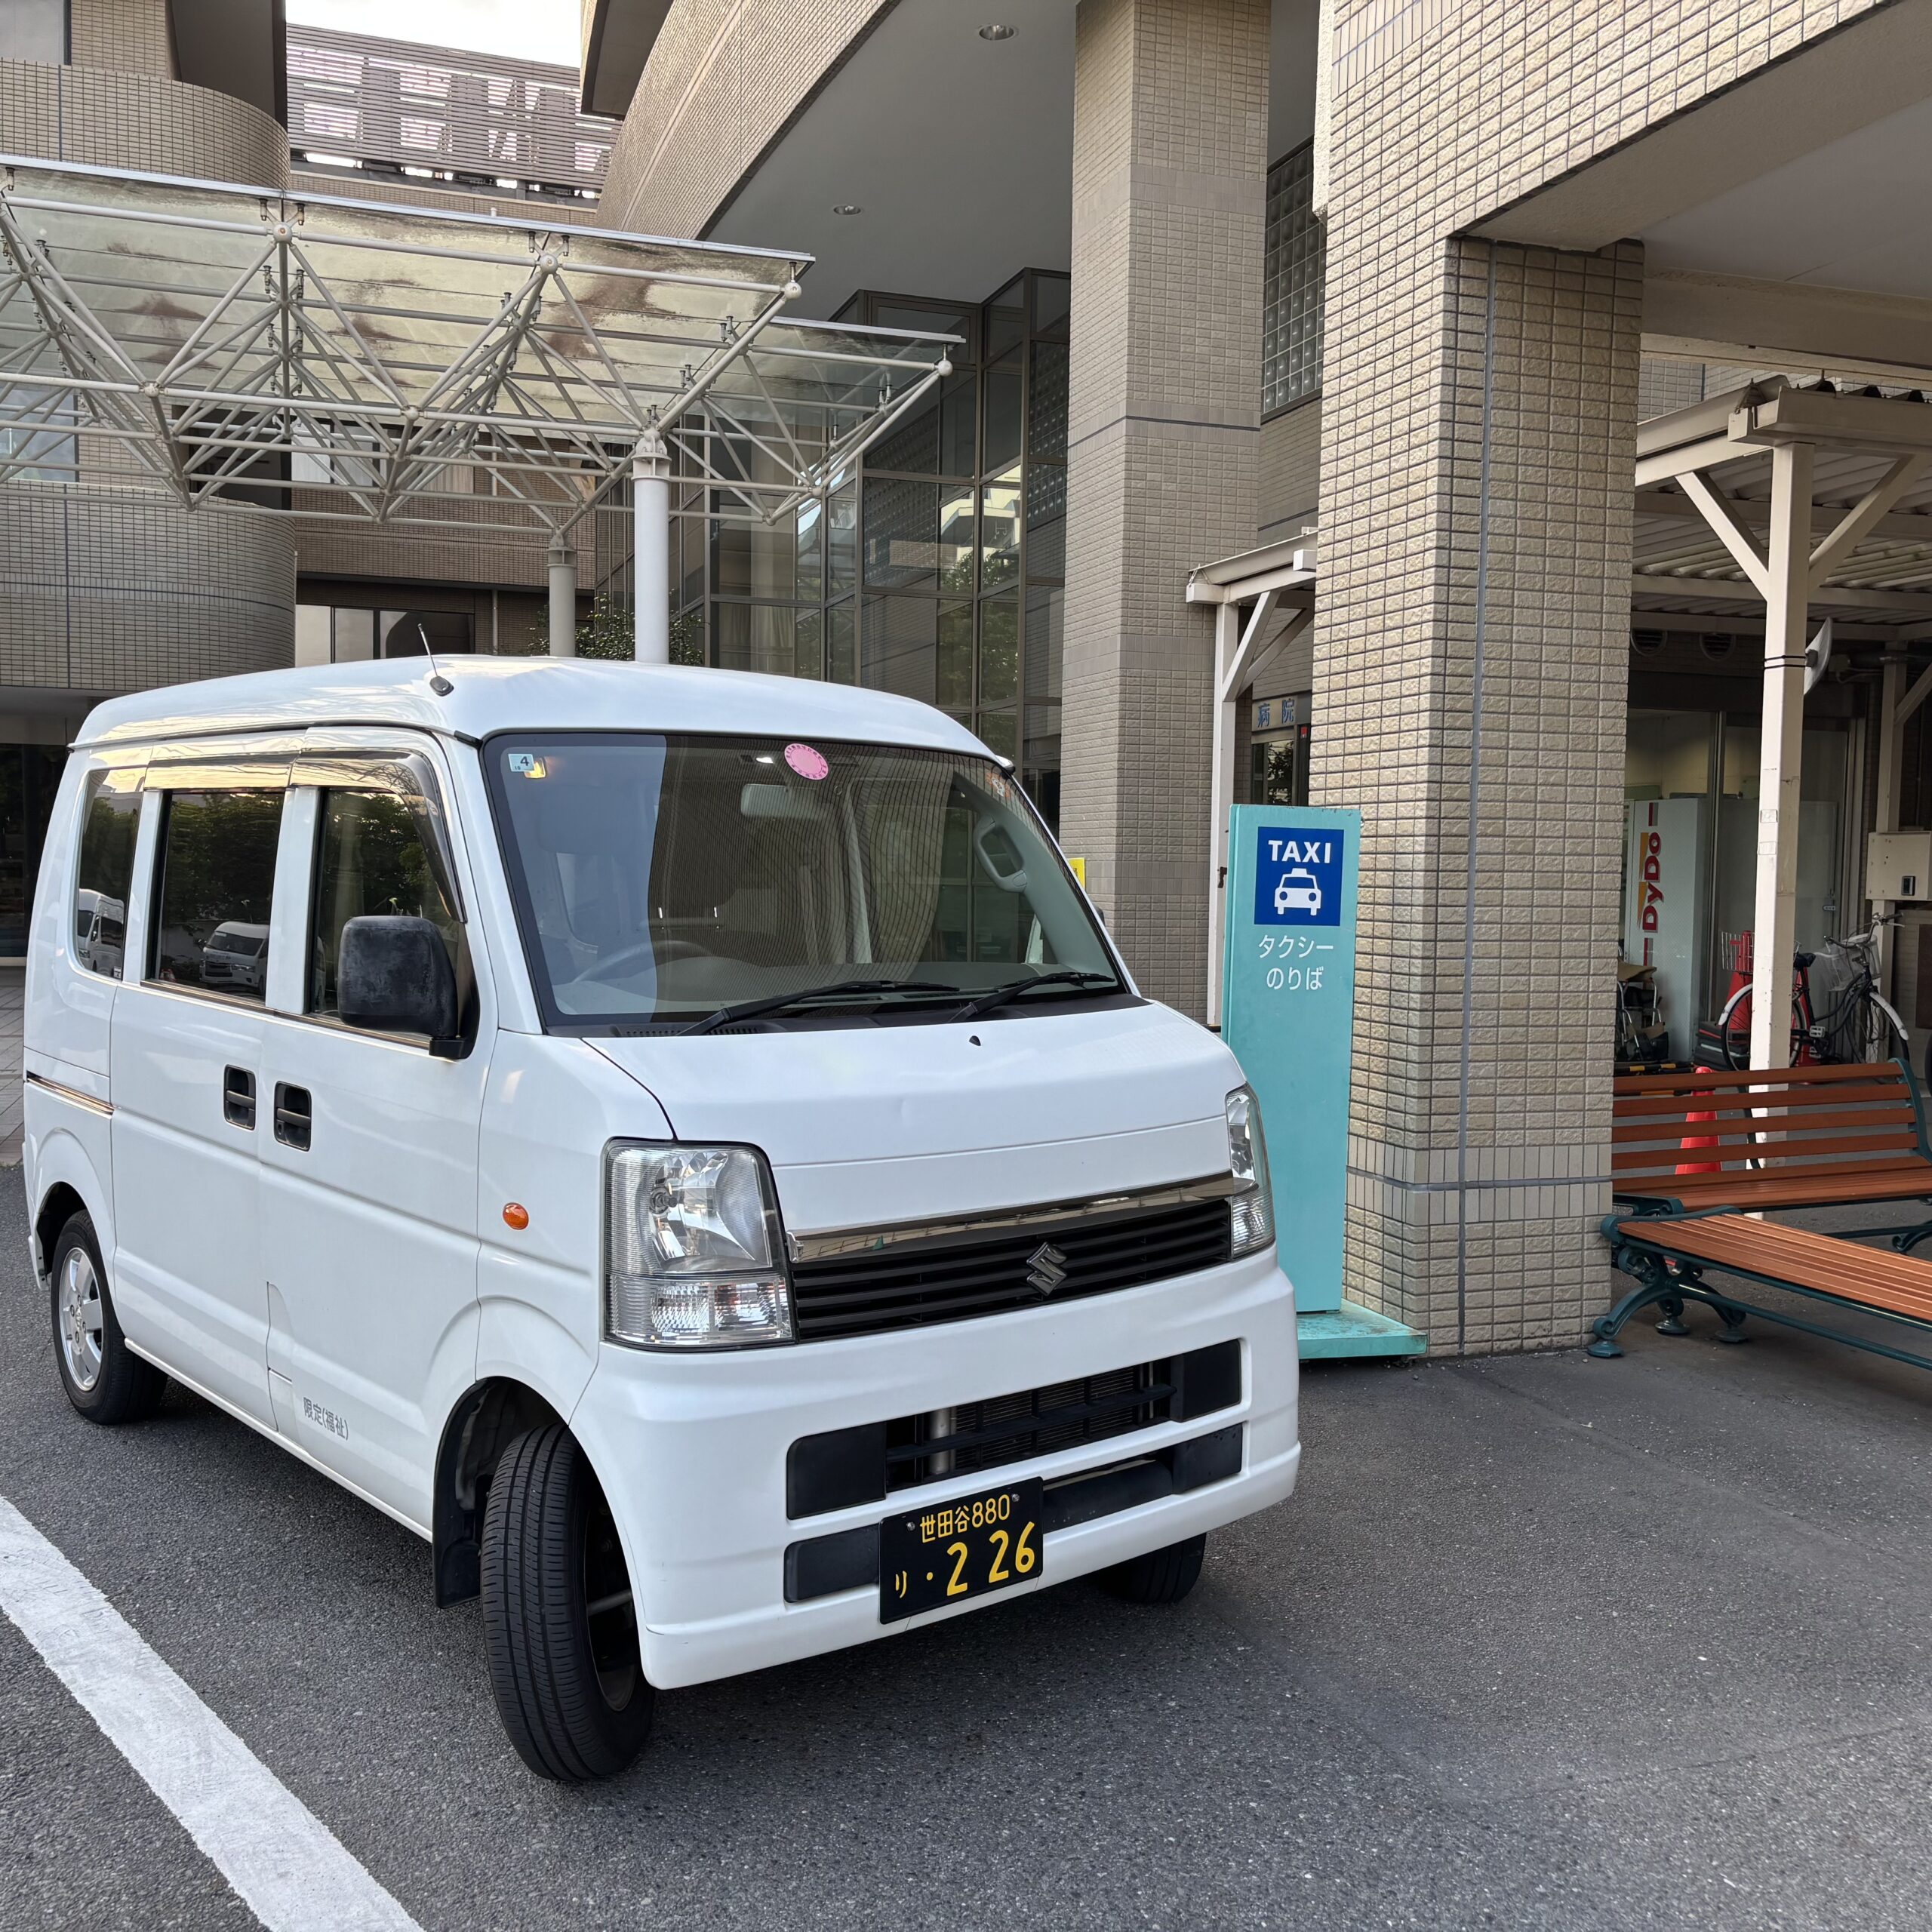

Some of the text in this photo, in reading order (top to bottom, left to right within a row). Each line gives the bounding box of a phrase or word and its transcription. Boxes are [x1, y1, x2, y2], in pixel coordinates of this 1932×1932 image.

[1257, 698, 1295, 728] 病院
[520, 755, 530, 767] 4
[1267, 839, 1331, 864] TAXI
[1642, 832, 1664, 933] DyDo
[1258, 934, 1334, 959] タクシー
[1266, 966, 1324, 990] のりば
